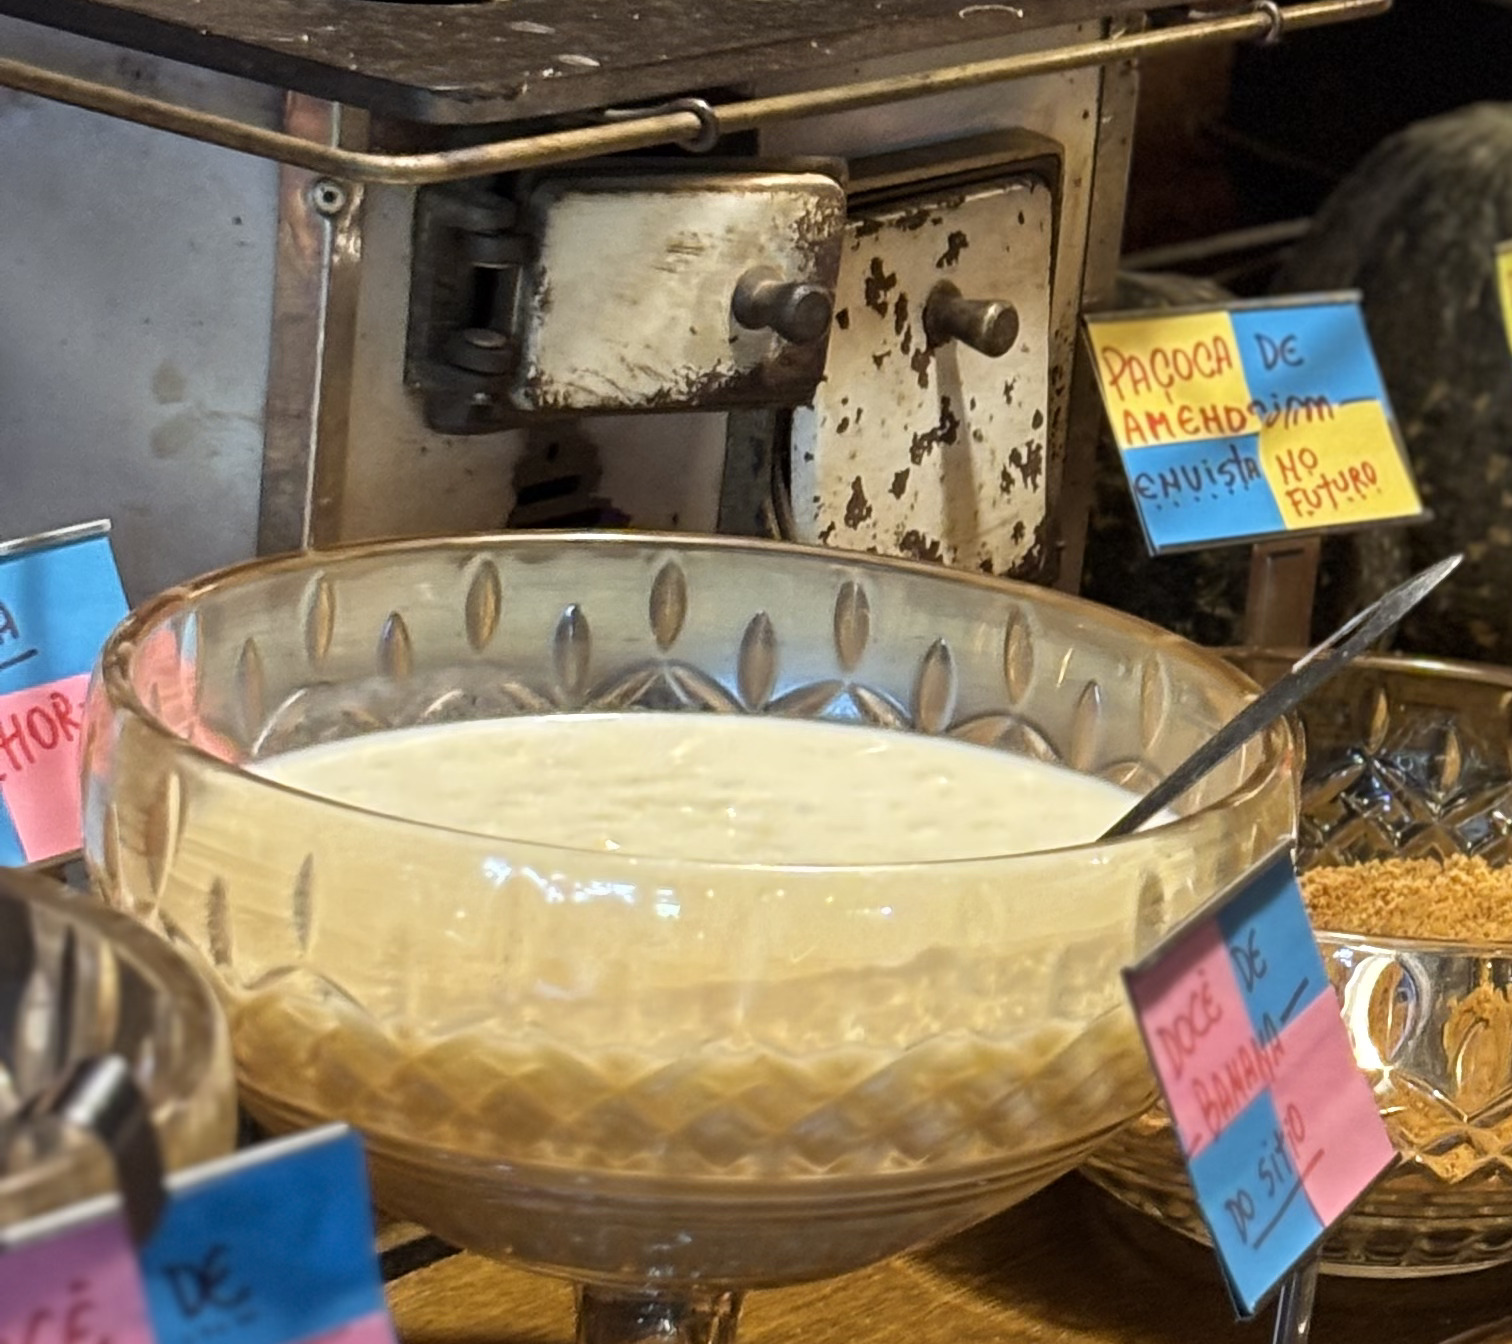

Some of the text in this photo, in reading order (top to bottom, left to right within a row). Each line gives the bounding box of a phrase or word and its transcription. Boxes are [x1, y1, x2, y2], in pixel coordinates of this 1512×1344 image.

[1101, 333, 1304, 404] PAÇOCA DE
[1275, 447, 1319, 485] NO
[1285, 460, 1379, 518] FUTURO
[1231, 927, 1268, 993] DE
[1191, 1012, 1286, 1142] BANANA
[1223, 1188, 1256, 1246] DO
[161, 1241, 253, 1319] DE
